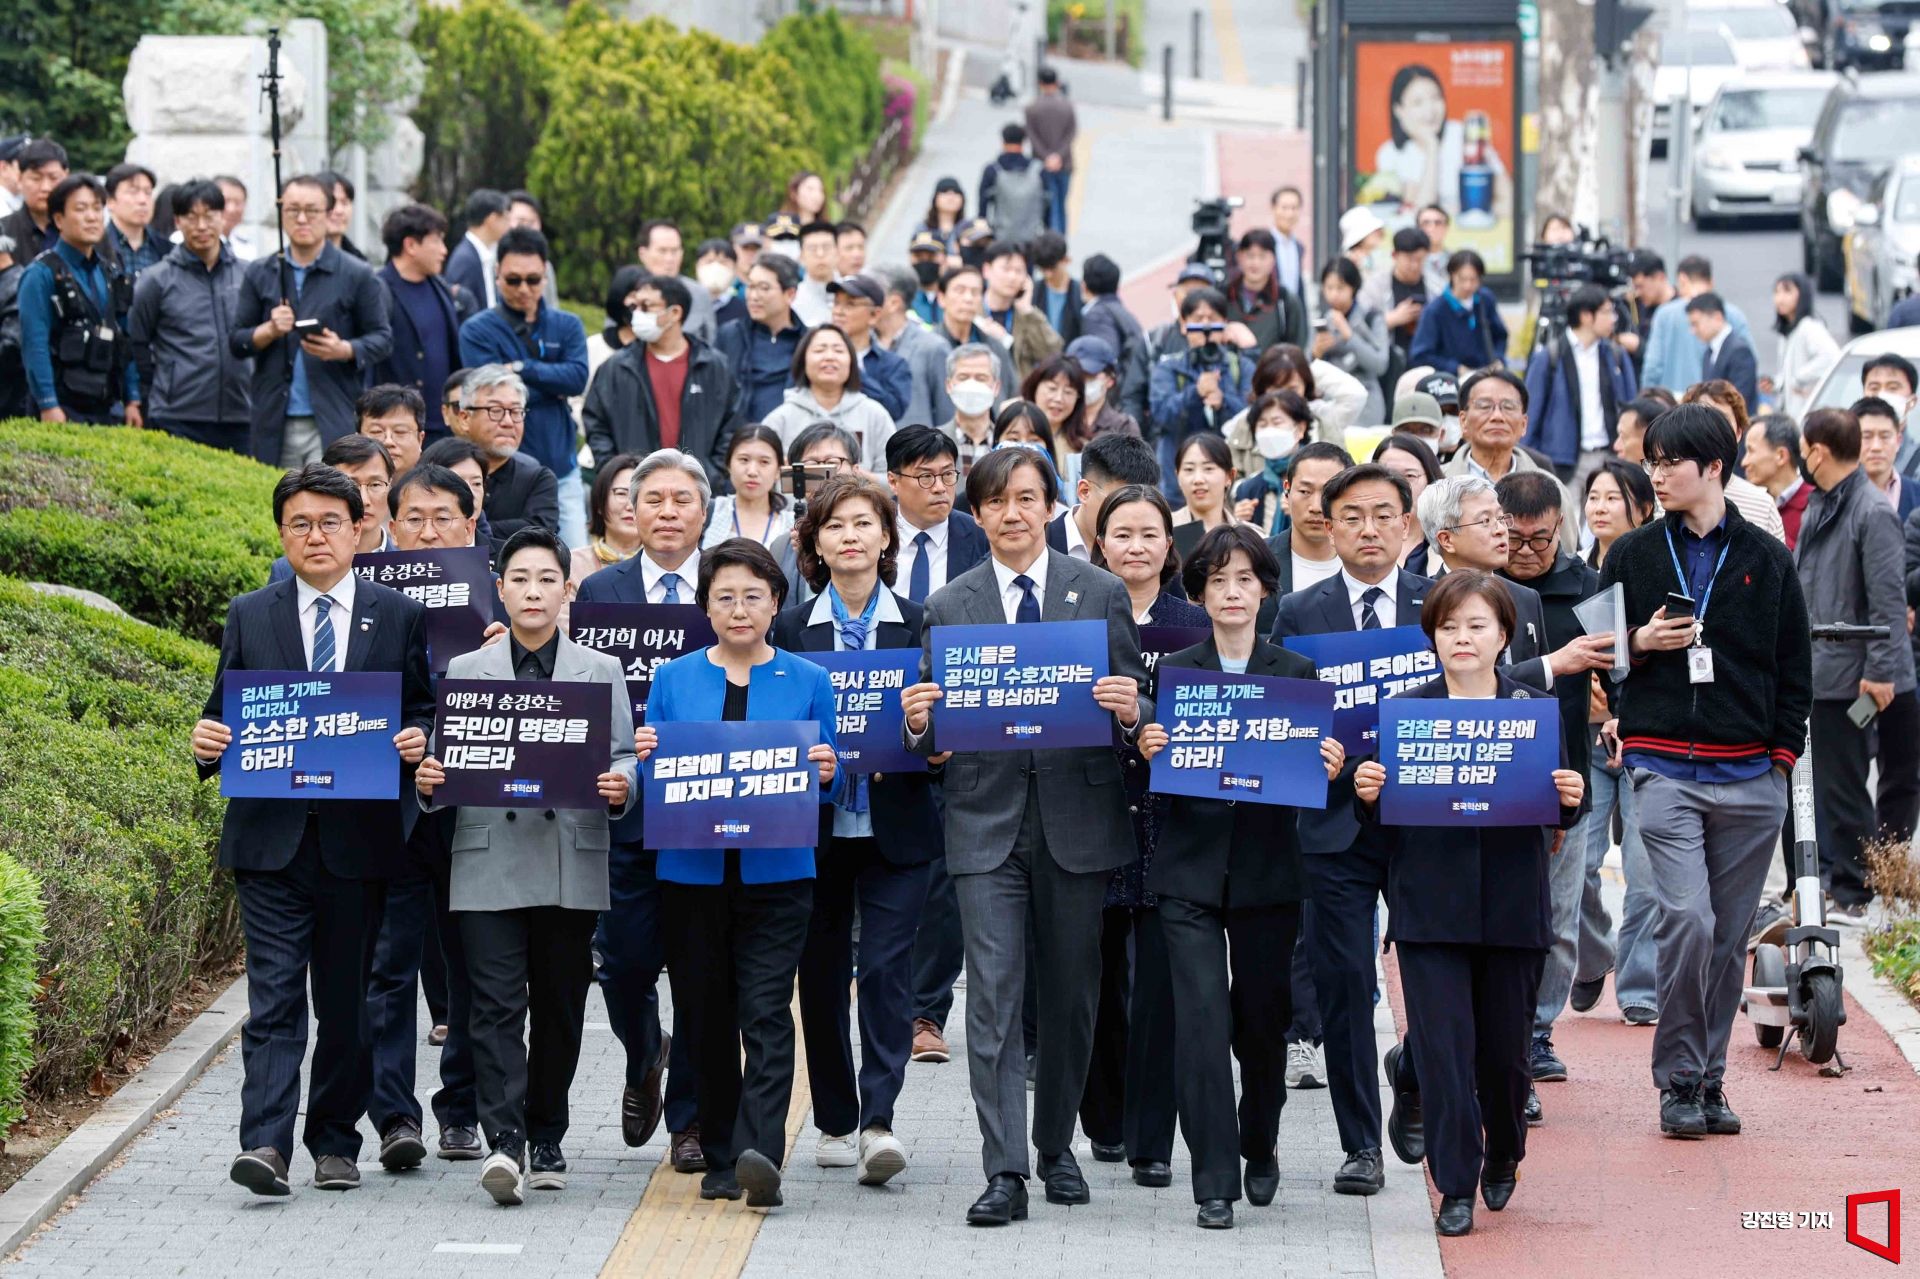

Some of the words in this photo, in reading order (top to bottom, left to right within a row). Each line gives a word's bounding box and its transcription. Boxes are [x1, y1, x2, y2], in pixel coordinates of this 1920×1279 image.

[380, 562, 443, 582] 송경호는
[403, 582, 470, 609] 명령을
[575, 627, 637, 650] 김건희
[643, 628, 686, 650] 여사
[944, 645, 1016, 667] 검사들은
[1369, 650, 1436, 679] 주어진
[829, 670, 865, 690] 역사
[868, 669, 904, 689] 앞에
[944, 667, 999, 687] 공익의
[1003, 664, 1093, 686] 수호자라는
[1316, 661, 1364, 686] 찰에
[241, 684, 284, 703] 검사들
[288, 681, 332, 698] 기개는
[445, 692, 494, 710] 이원석
[498, 693, 563, 712] 송경호는
[847, 692, 883, 712] 않은
[945, 689, 982, 708] 본분
[986, 686, 1059, 708] 명심하라
[1175, 684, 1218, 700] 검사들
[1221, 684, 1265, 699] 기개는
[1333, 684, 1378, 711] 지막
[241, 701, 300, 720] 어디갔나
[1174, 702, 1232, 717] 어디갔나
[239, 717, 309, 745] 소소한
[313, 712, 389, 737] 저항이라도
[443, 716, 514, 742] 국민의
[518, 718, 589, 743] 명령을
[1005, 725, 1042, 735] 조국혁신당
[1170, 719, 1240, 742] 소소한
[1244, 718, 1319, 741] 저항이라도
[1396, 719, 1452, 739] 검찰은
[1456, 719, 1495, 739] 역사
[1497, 719, 1536, 739] 앞에
[240, 745, 295, 772] 하라!
[442, 745, 516, 771] 따르라
[653, 752, 723, 780] 검찰에
[728, 746, 798, 772] 주어진
[1170, 746, 1224, 769] 하라!
[1397, 742, 1472, 762] 부끄럽지
[1475, 742, 1513, 762] 않은
[295, 775, 332, 784] 조국혁신당
[1223, 776, 1260, 788] 조국혁신당
[1398, 765, 1453, 785] 결정을
[1457, 765, 1497, 785] 하라
[503, 784, 540, 793] 조국혁신당
[664, 777, 734, 804] 마지막
[738, 770, 809, 798] 기회다
[1452, 802, 1489, 811] 조국혁신당
[714, 824, 750, 833] 조국혁신당
